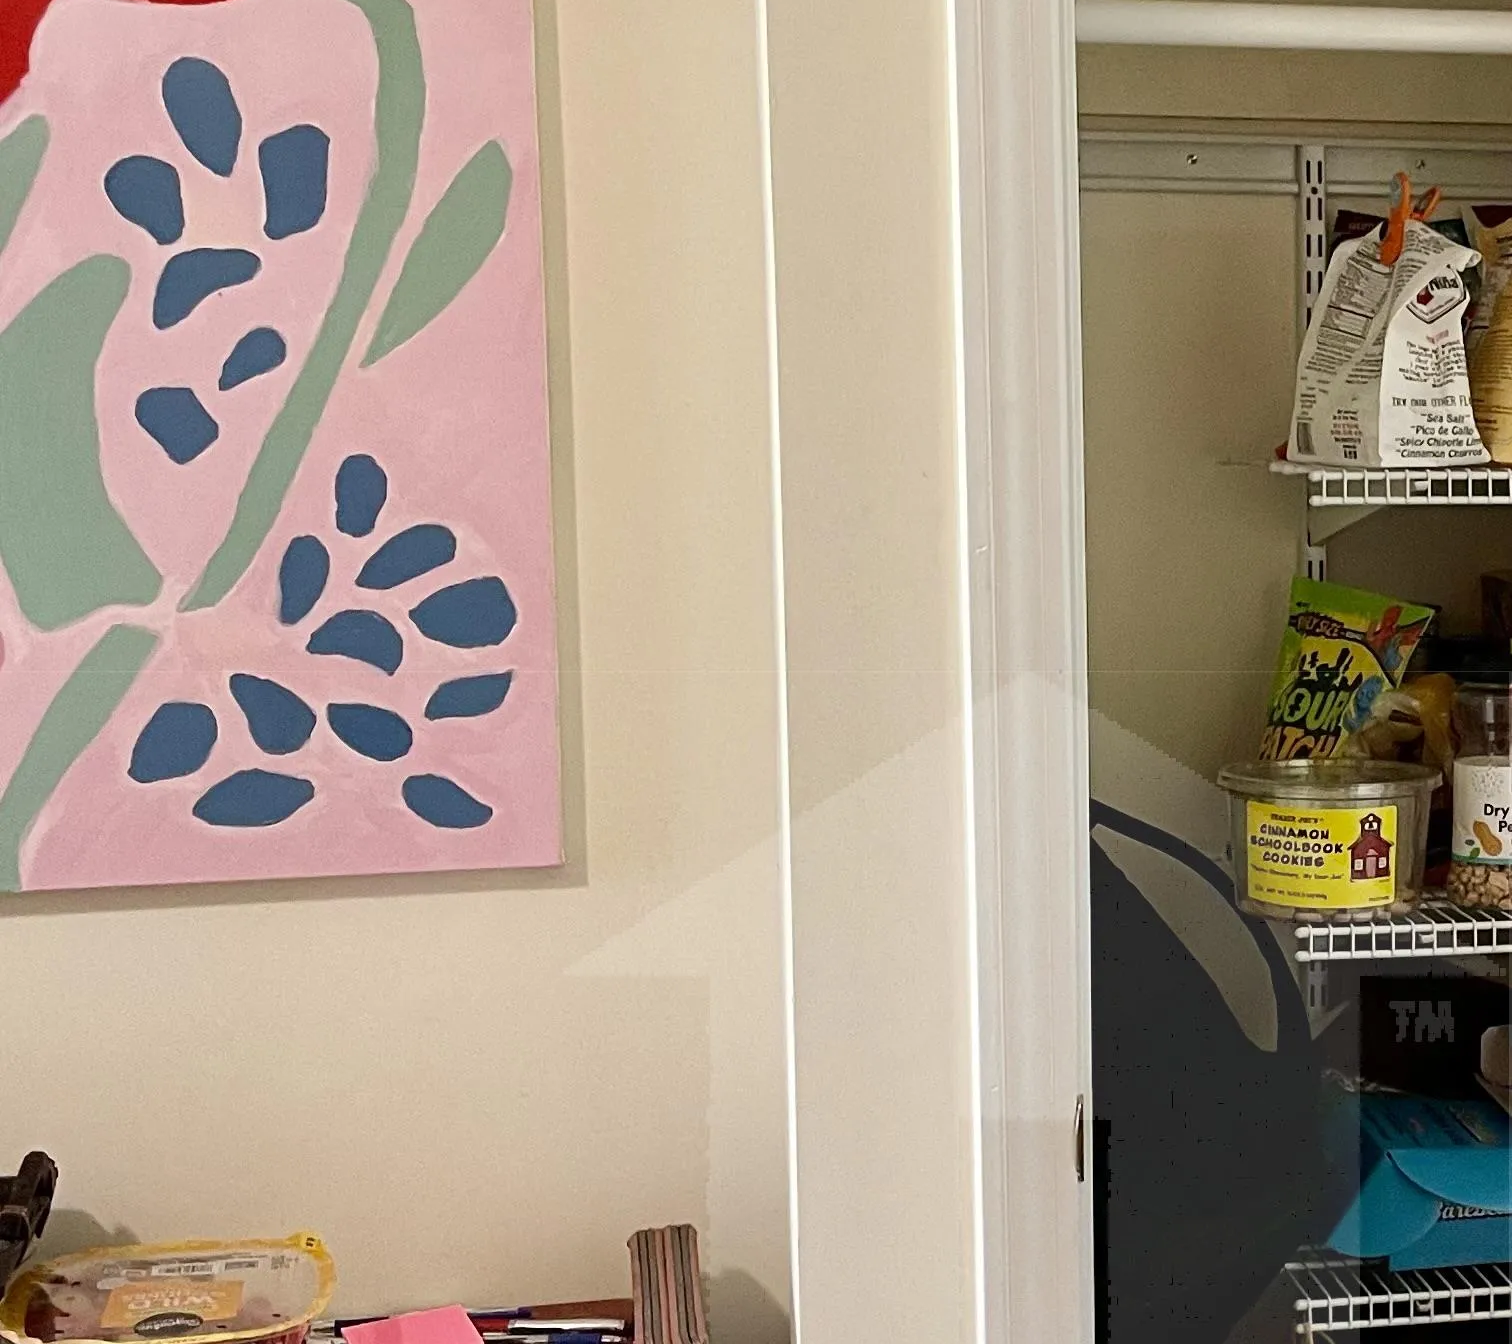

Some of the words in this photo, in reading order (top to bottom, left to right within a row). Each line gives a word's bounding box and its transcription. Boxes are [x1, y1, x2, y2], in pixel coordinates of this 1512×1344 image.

[1483, 803, 1510, 819] Dry
[1260, 823, 1329, 840] CINNAMON
[1250, 835, 1344, 854] SCHOOLBOOK
[1263, 851, 1325, 867] COOKIES
